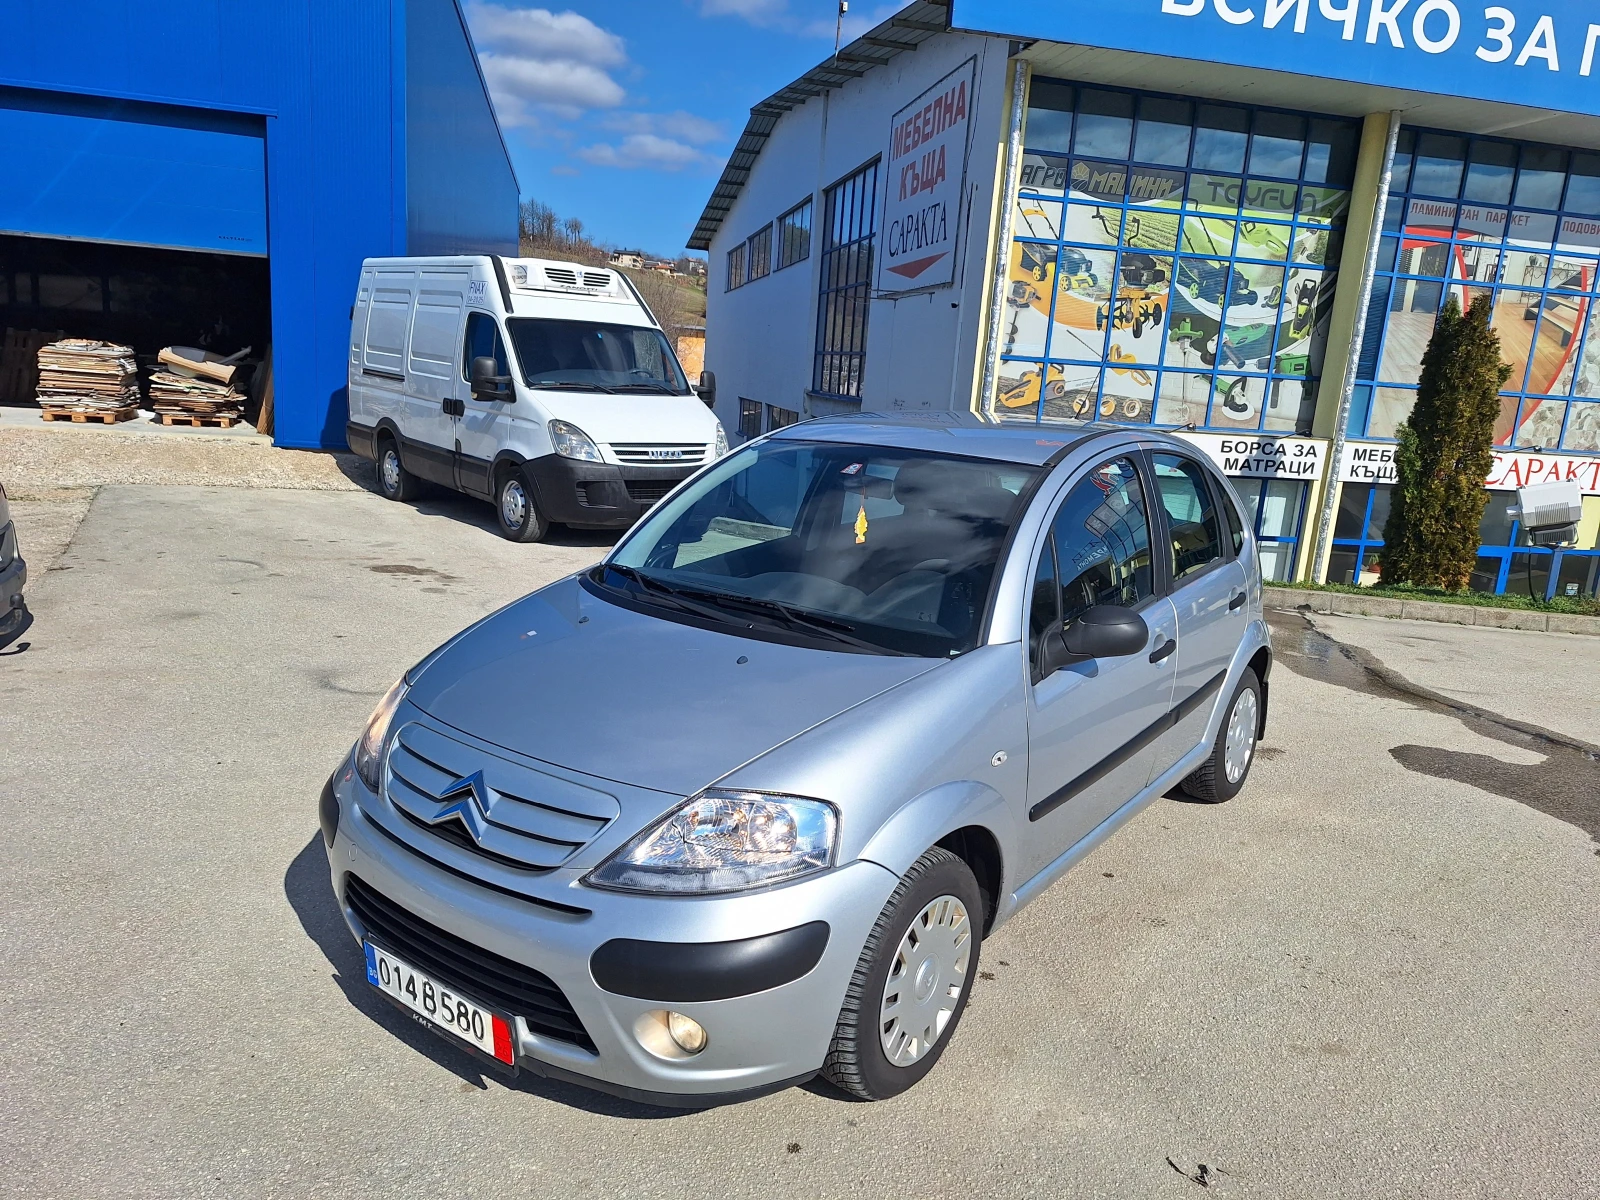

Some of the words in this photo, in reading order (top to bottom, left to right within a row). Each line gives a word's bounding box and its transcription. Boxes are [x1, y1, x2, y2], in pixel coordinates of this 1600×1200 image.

[1475, 6, 1560, 72] ЗА
[893, 80, 966, 161] МЕБЕЛНА
[899, 144, 946, 202] КЪЩА
[1020, 165, 1067, 188] АГРО
[1410, 202, 1479, 221] ЛАМИНИРАН
[1485, 211, 1530, 227] ПАРКЕТ
[888, 200, 947, 257] САРАКТА
[649, 450, 682, 458] IVECO
[1220, 440, 1287, 457] БОРСА
[1293, 444, 1318, 458] ЗА
[1223, 458, 1315, 476] МАТРАЦИ
